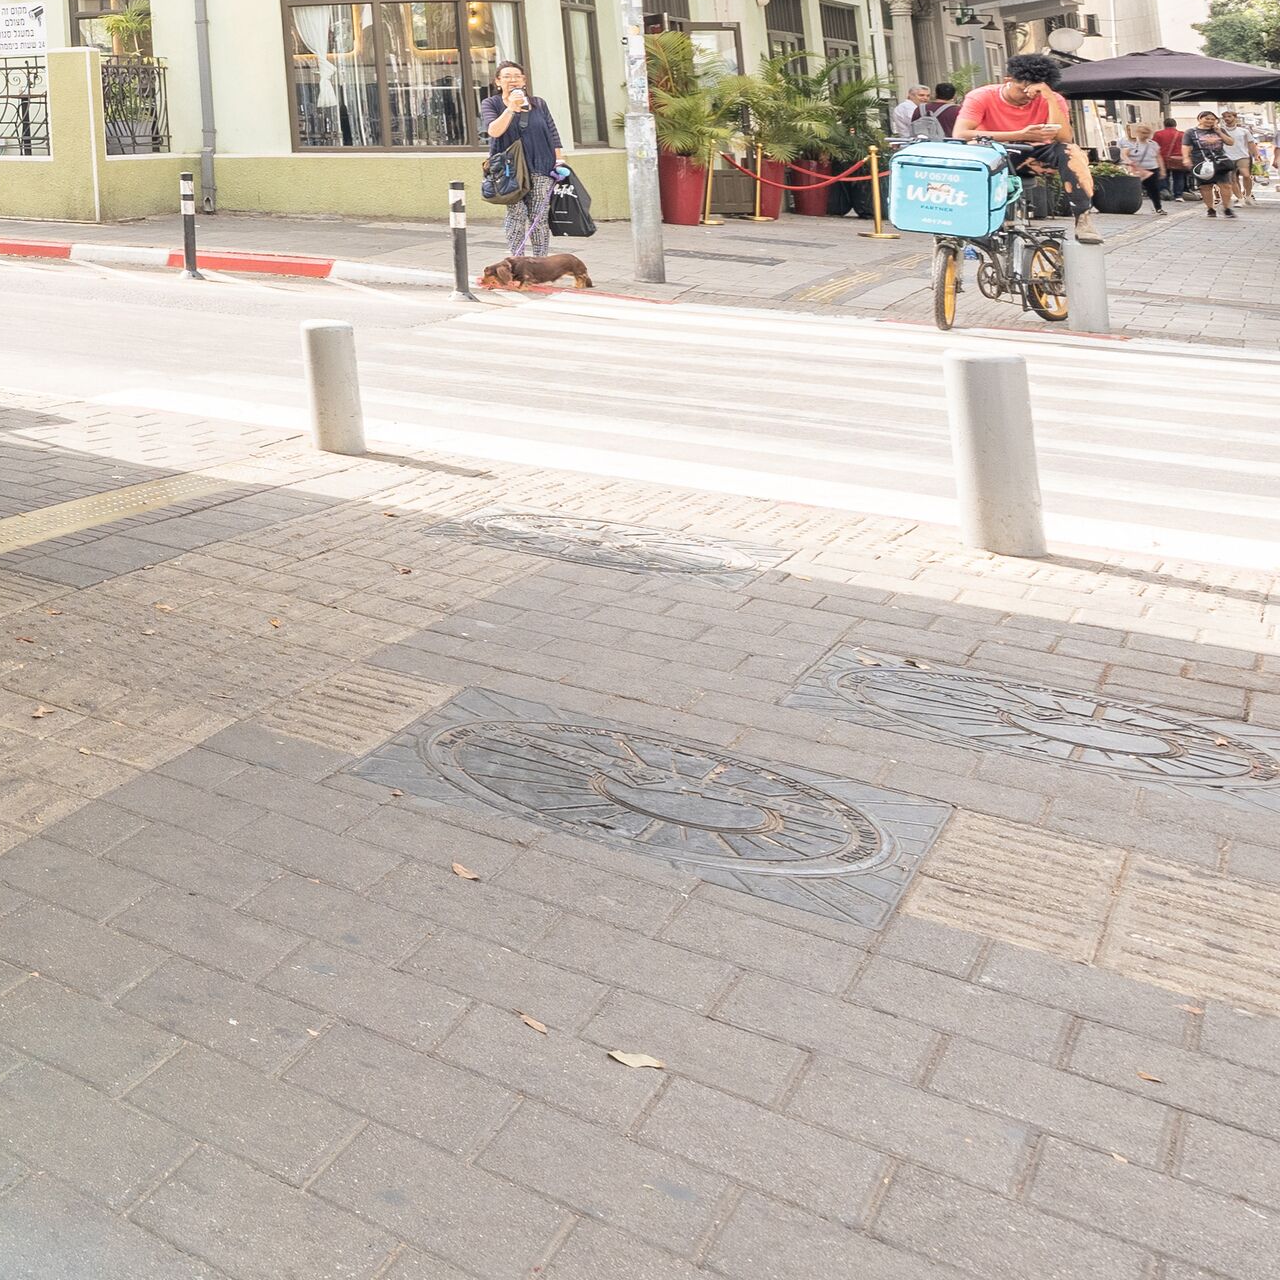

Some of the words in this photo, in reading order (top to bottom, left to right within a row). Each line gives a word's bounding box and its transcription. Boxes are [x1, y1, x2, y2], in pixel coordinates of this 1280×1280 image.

[10, 6, 27, 16] מקום
[914, 170, 928, 179] W
[906, 183, 969, 207] Wolt
[920, 205, 954, 213] PARTNER
